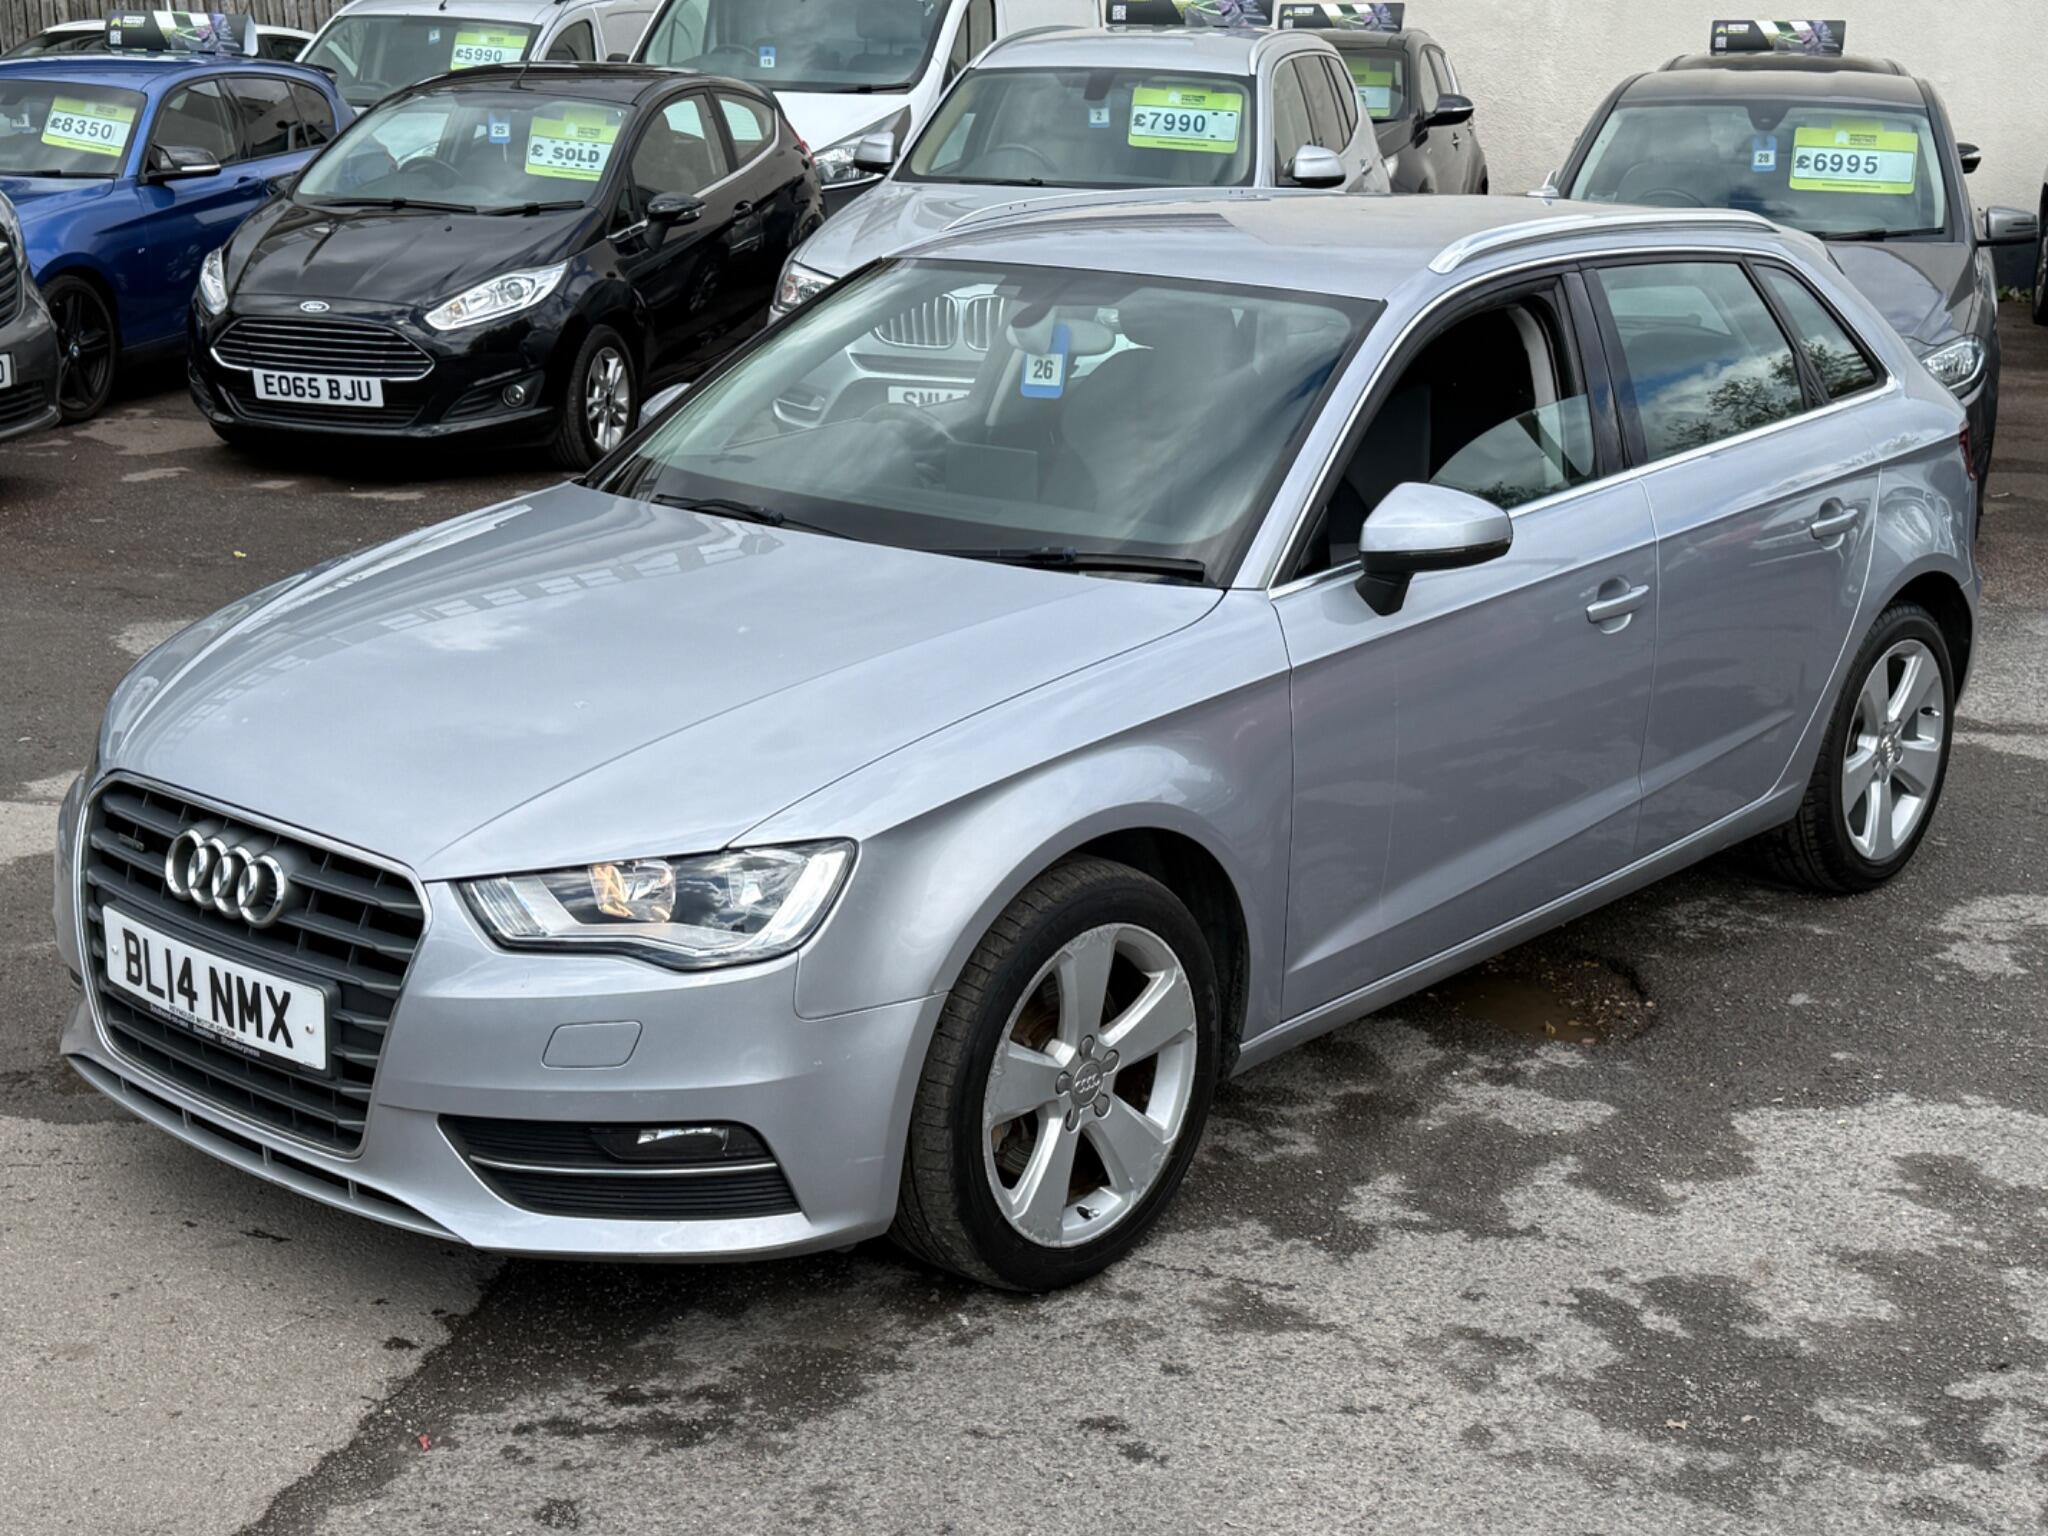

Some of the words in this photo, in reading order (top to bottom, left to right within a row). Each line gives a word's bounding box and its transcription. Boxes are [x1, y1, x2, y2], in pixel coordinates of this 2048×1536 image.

[455, 47, 503, 63] £5990
[50, 117, 113, 140] £8350
[494, 125, 506, 135] 25
[1133, 111, 1206, 132] £7990
[552, 146, 600, 163] SOLD
[1757, 153, 1770, 163] 28
[1796, 152, 1879, 174] £6995
[1033, 359, 1054, 380] 26
[327, 378, 372, 401] BJU
[122, 927, 199, 1013] BL14
[209, 965, 294, 1050] NMX
